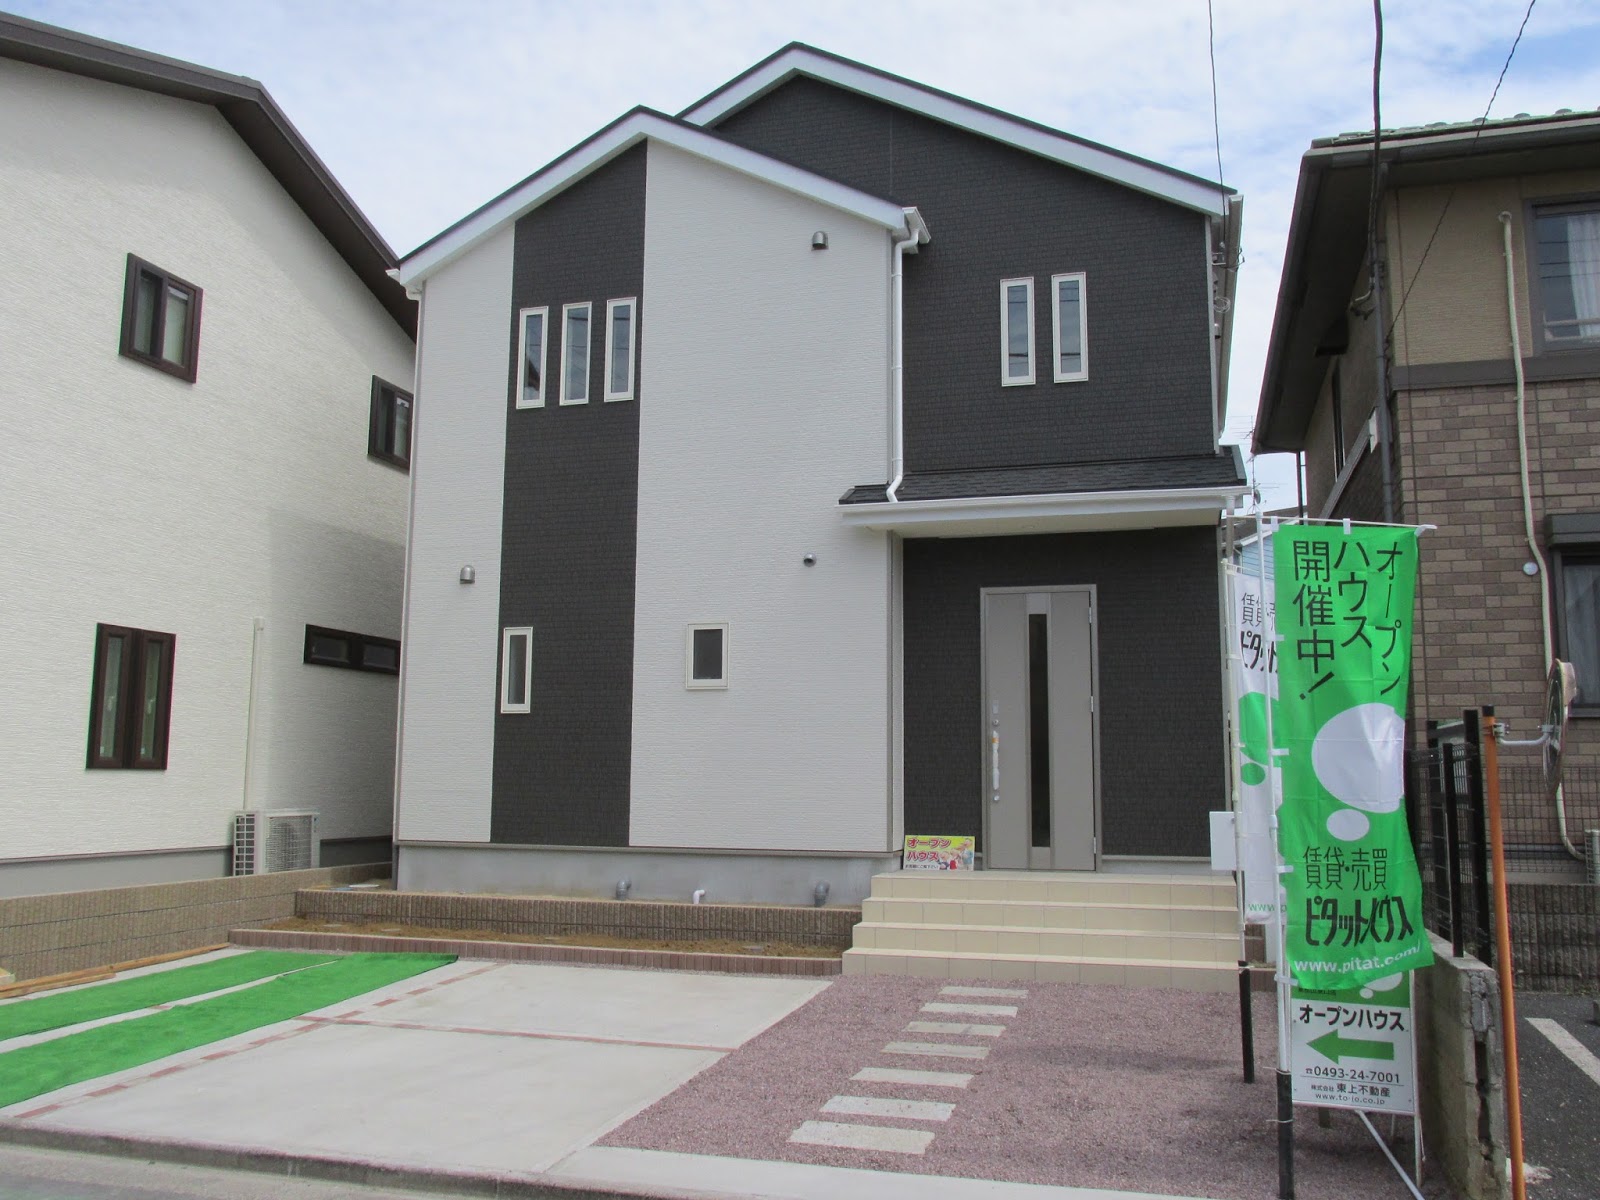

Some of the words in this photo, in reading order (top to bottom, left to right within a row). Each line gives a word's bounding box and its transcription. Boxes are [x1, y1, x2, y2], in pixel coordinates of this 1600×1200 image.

[1333, 541, 1373, 649] ハウス
[1376, 541, 1403, 696] オープン
[1292, 540, 1336, 701] 開催中!
[907, 851, 938, 861] ハウス
[1303, 846, 1388, 892] 賃貸・売買
[1305, 895, 1414, 947] ピタットハウス
[1294, 941, 1421, 974] www.pitat.com/
[1299, 1004, 1405, 1032] オープンハウス
